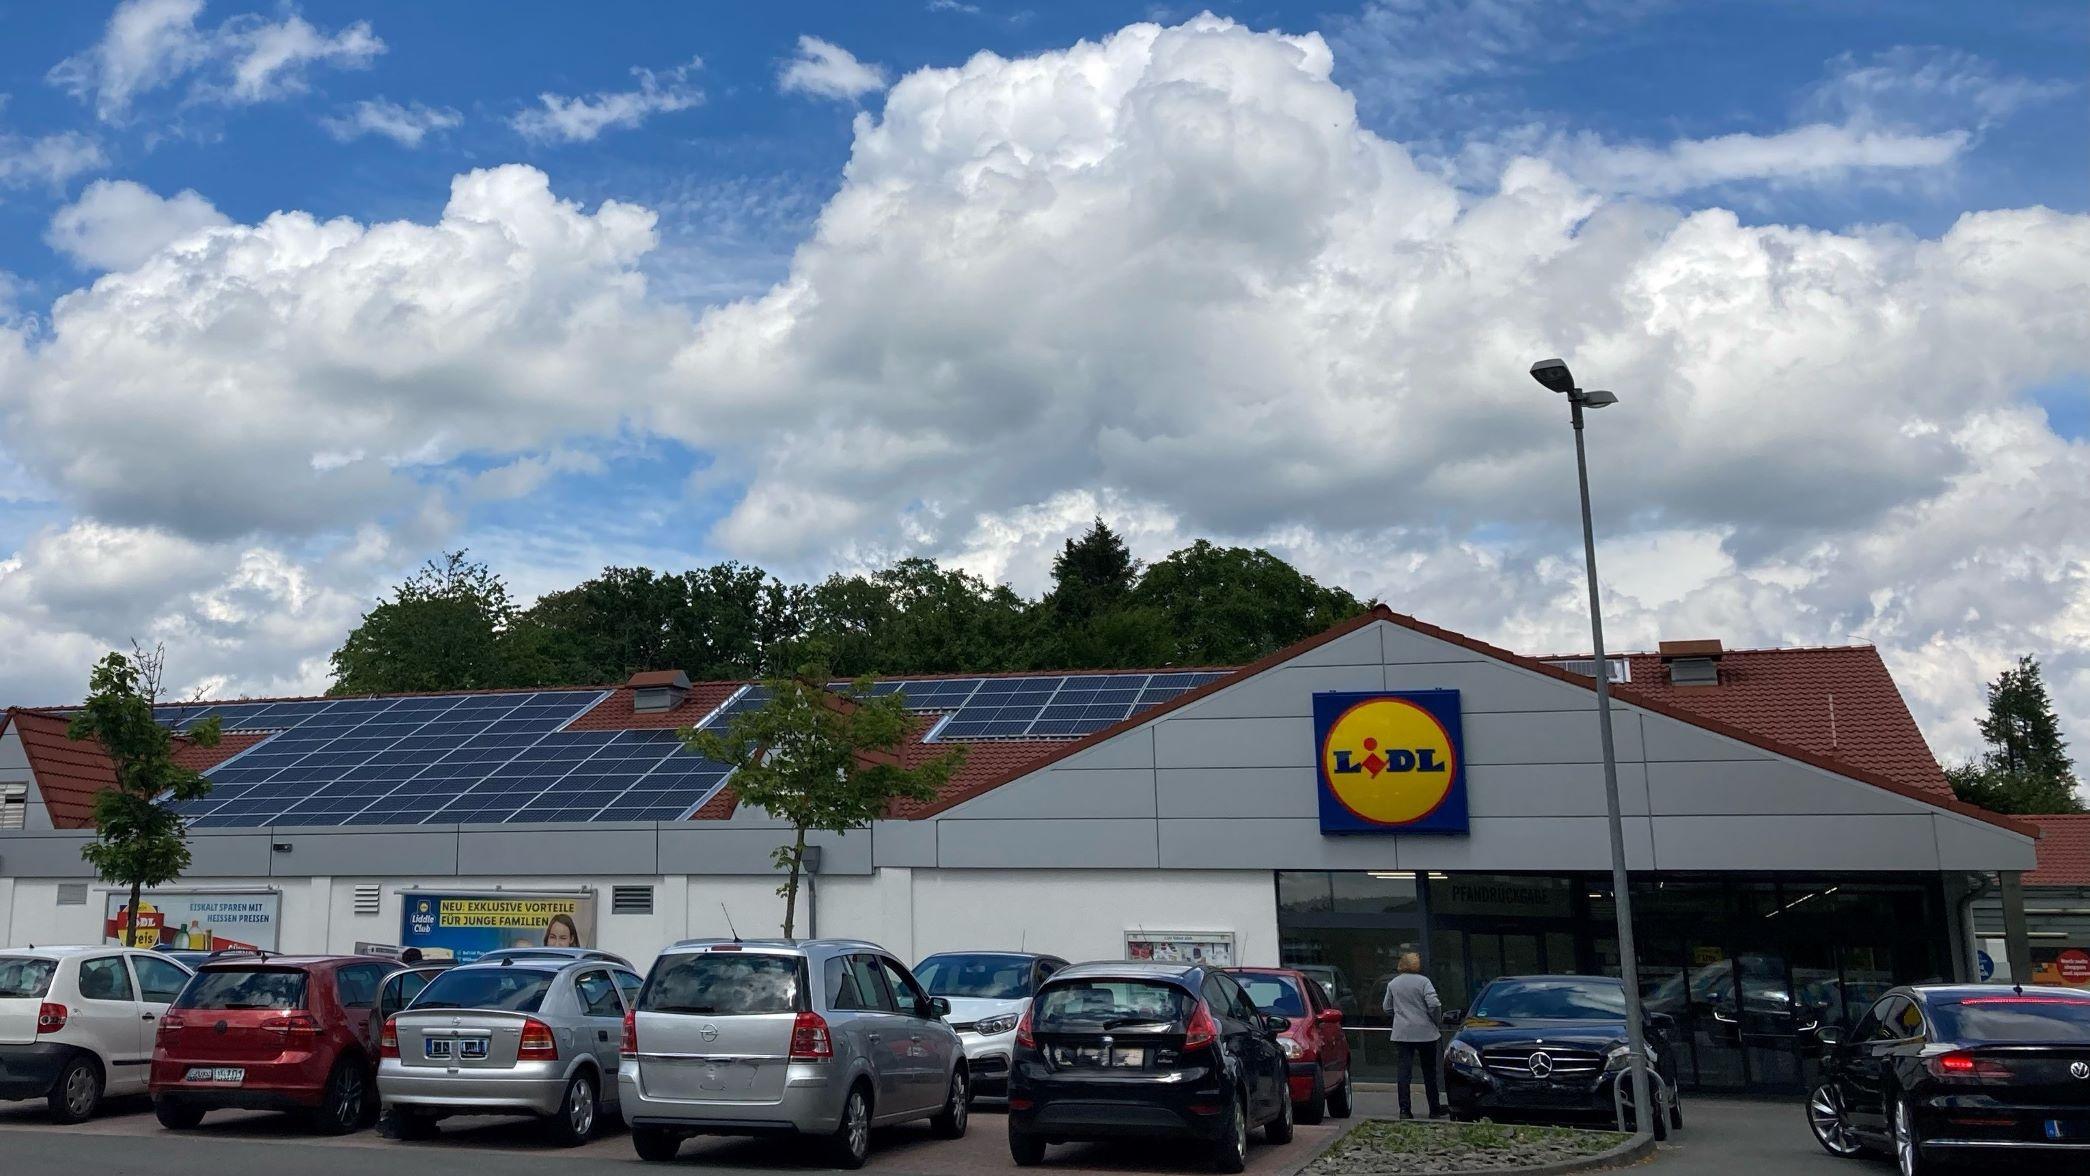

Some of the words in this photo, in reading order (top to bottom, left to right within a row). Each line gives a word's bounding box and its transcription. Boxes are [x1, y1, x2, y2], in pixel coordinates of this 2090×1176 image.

[189, 903, 217, 912] EISKALT
[220, 903, 247, 912] SPAREN
[249, 903, 263, 912] MIT
[442, 902, 466, 912] NEU:
[468, 902, 522, 912] EXKLUSIVE
[524, 902, 575, 913] VORTEILE
[207, 914, 238, 923] HEISSEN
[239, 915, 270, 923] PREISEN
[412, 914, 434, 924] Liddle
[441, 913, 461, 926] FÜR
[463, 916, 497, 926] JUNGE
[499, 916, 549, 926] FAMILIEN
[414, 924, 431, 933] Club
